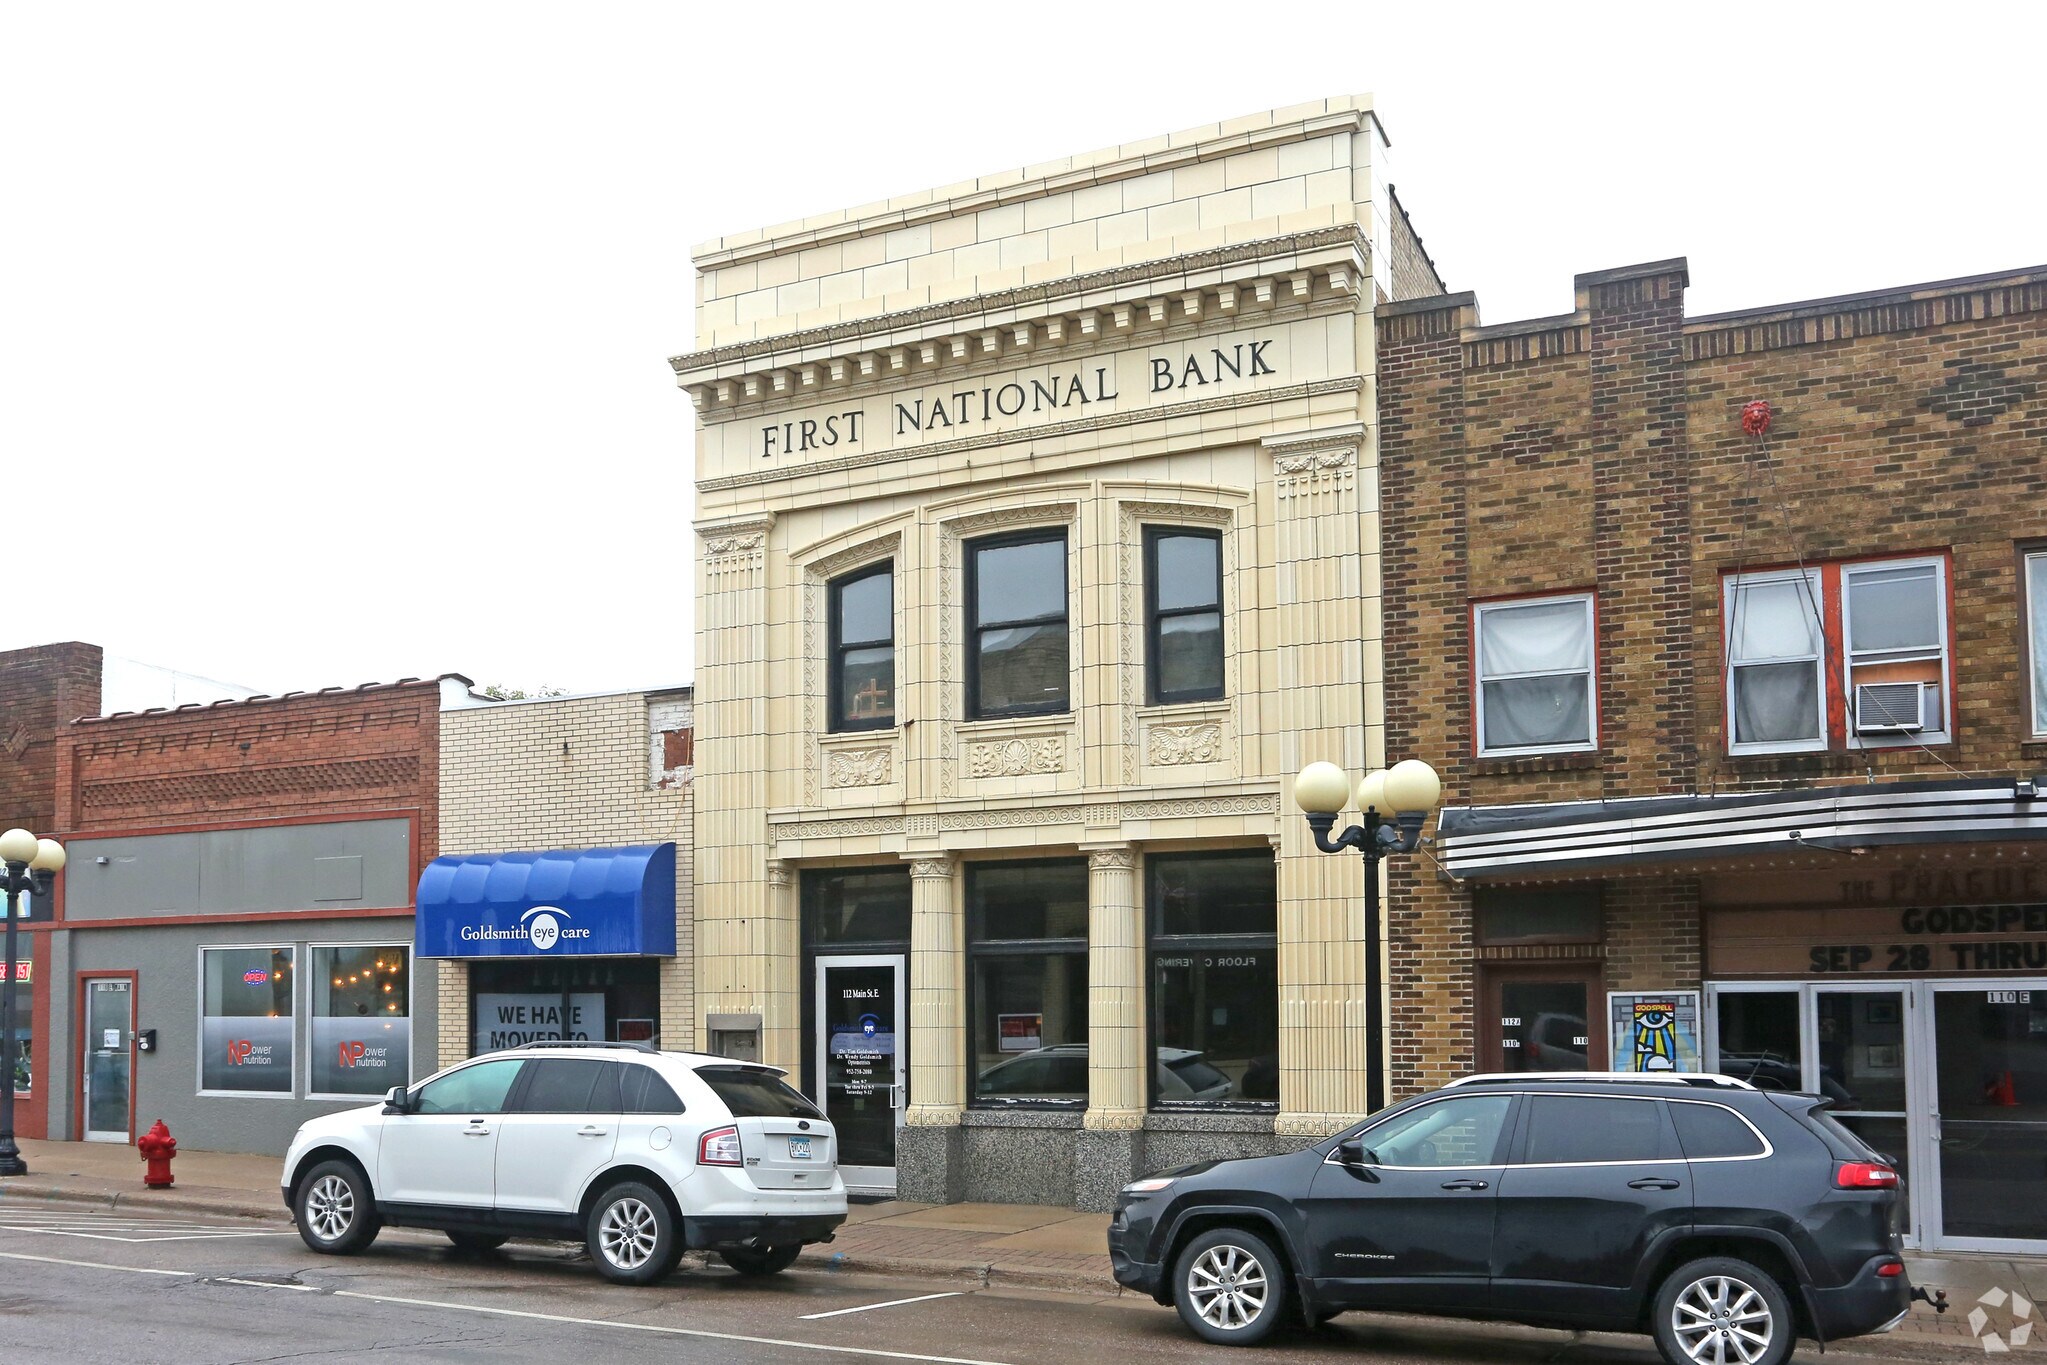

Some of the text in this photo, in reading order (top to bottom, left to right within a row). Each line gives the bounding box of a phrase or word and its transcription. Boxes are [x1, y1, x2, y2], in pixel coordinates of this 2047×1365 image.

[761, 339, 1276, 458] FIRST NATIONAL BANK
[1840, 866, 2043, 900] THE PRAGUE
[460, 924, 591, 943] Goldsmith eye care
[1809, 941, 2047, 972] SEP 28 THRU
[243, 973, 268, 982] OPEN
[842, 989, 852, 998] 112
[852, 989, 867, 998] Main
[1988, 991, 2030, 1003] 110 E
[497, 1006, 526, 1024] WE
[1573, 1037, 1589, 1045] 110
[243, 1055, 272, 1065] nutrition
[355, 1057, 387, 1067] nutrition
[1334, 1252, 1396, 1260] CHEROKEE
